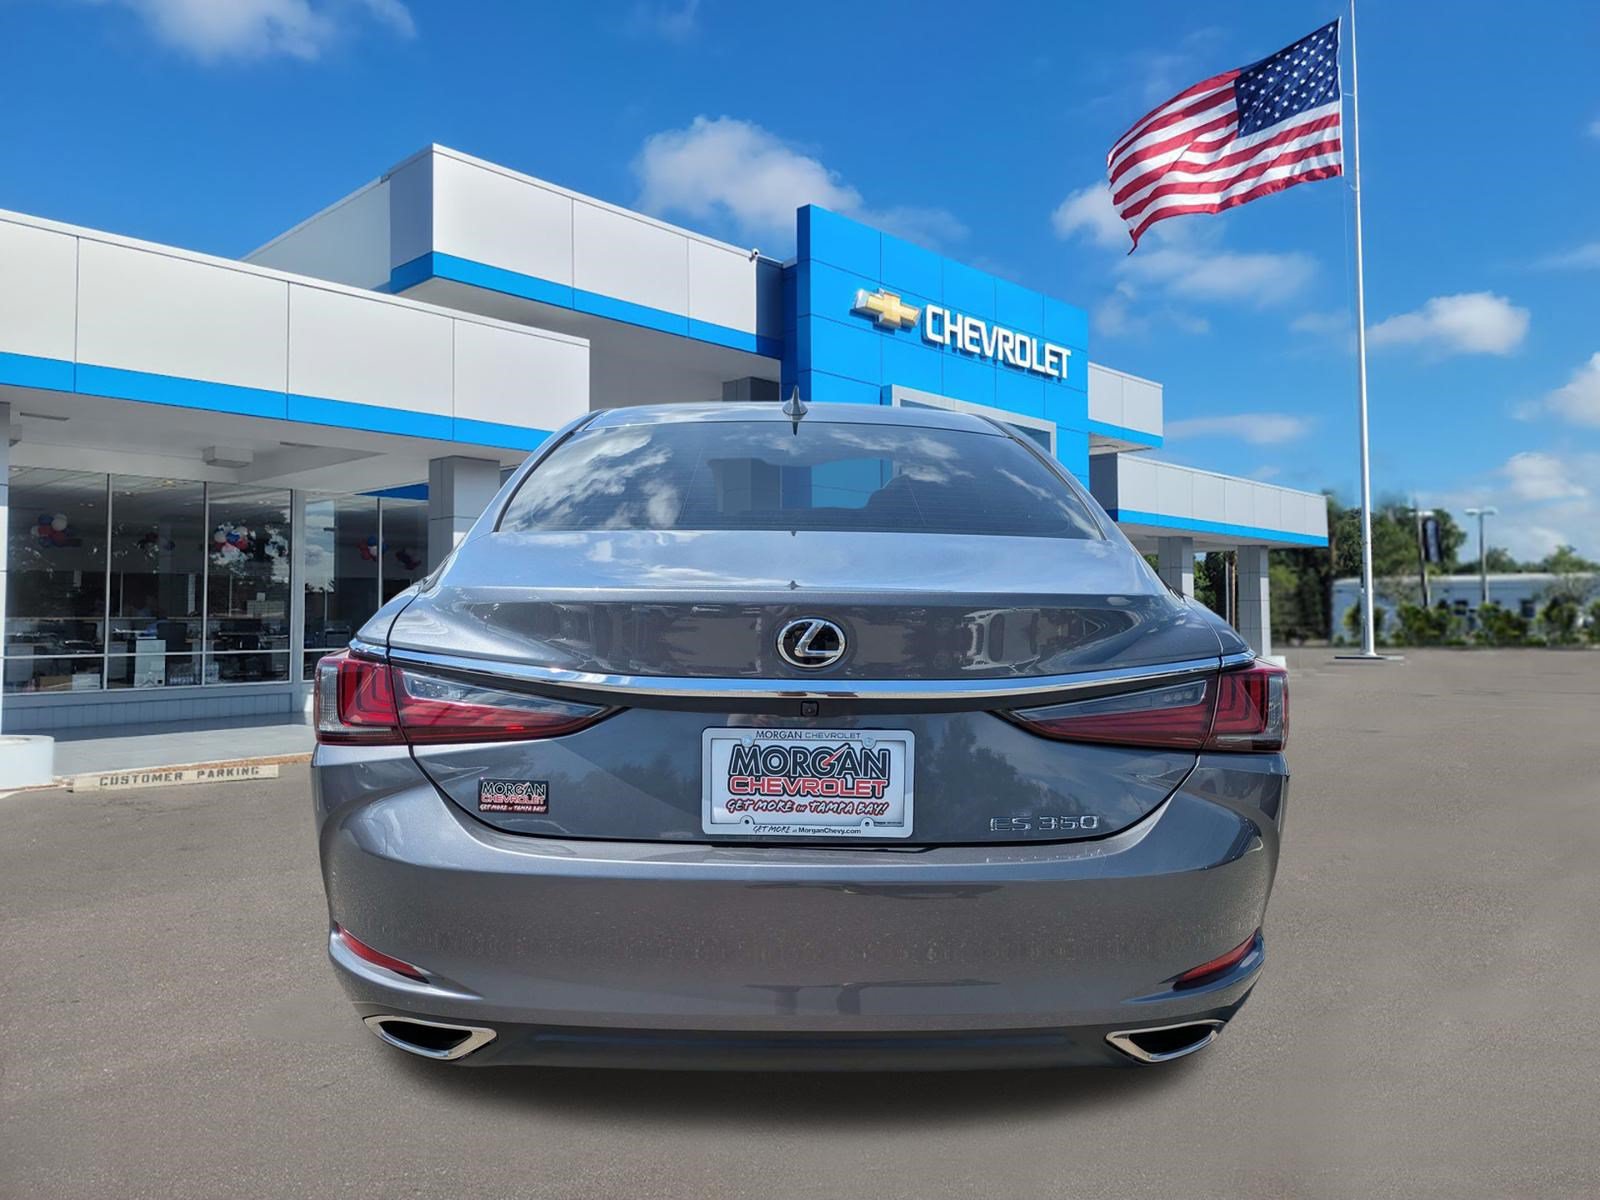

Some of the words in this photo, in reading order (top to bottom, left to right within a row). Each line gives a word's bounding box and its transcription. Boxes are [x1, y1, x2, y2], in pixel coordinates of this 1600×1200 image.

[923, 303, 1072, 379] CHEVROLET
[756, 730, 802, 739] MORGAN
[729, 743, 890, 778] MORGAN
[99, 772, 184, 786] CUSTOMER
[196, 766, 260, 779] PARKING
[481, 782, 547, 797] MORGAN
[730, 776, 888, 797] CHEVROLET
[480, 794, 545, 805] CHEVROLET
[727, 799, 753, 813] GET
[753, 799, 794, 812] MORE
[809, 800, 854, 814] TAMPA
[856, 801, 889, 815] BAY!
[753, 825, 769, 834] GET
[769, 826, 792, 834] MORE
[798, 827, 862, 836] MorganChevy.com
[989, 817, 1033, 831] ES
[1038, 815, 1100, 830] 350
